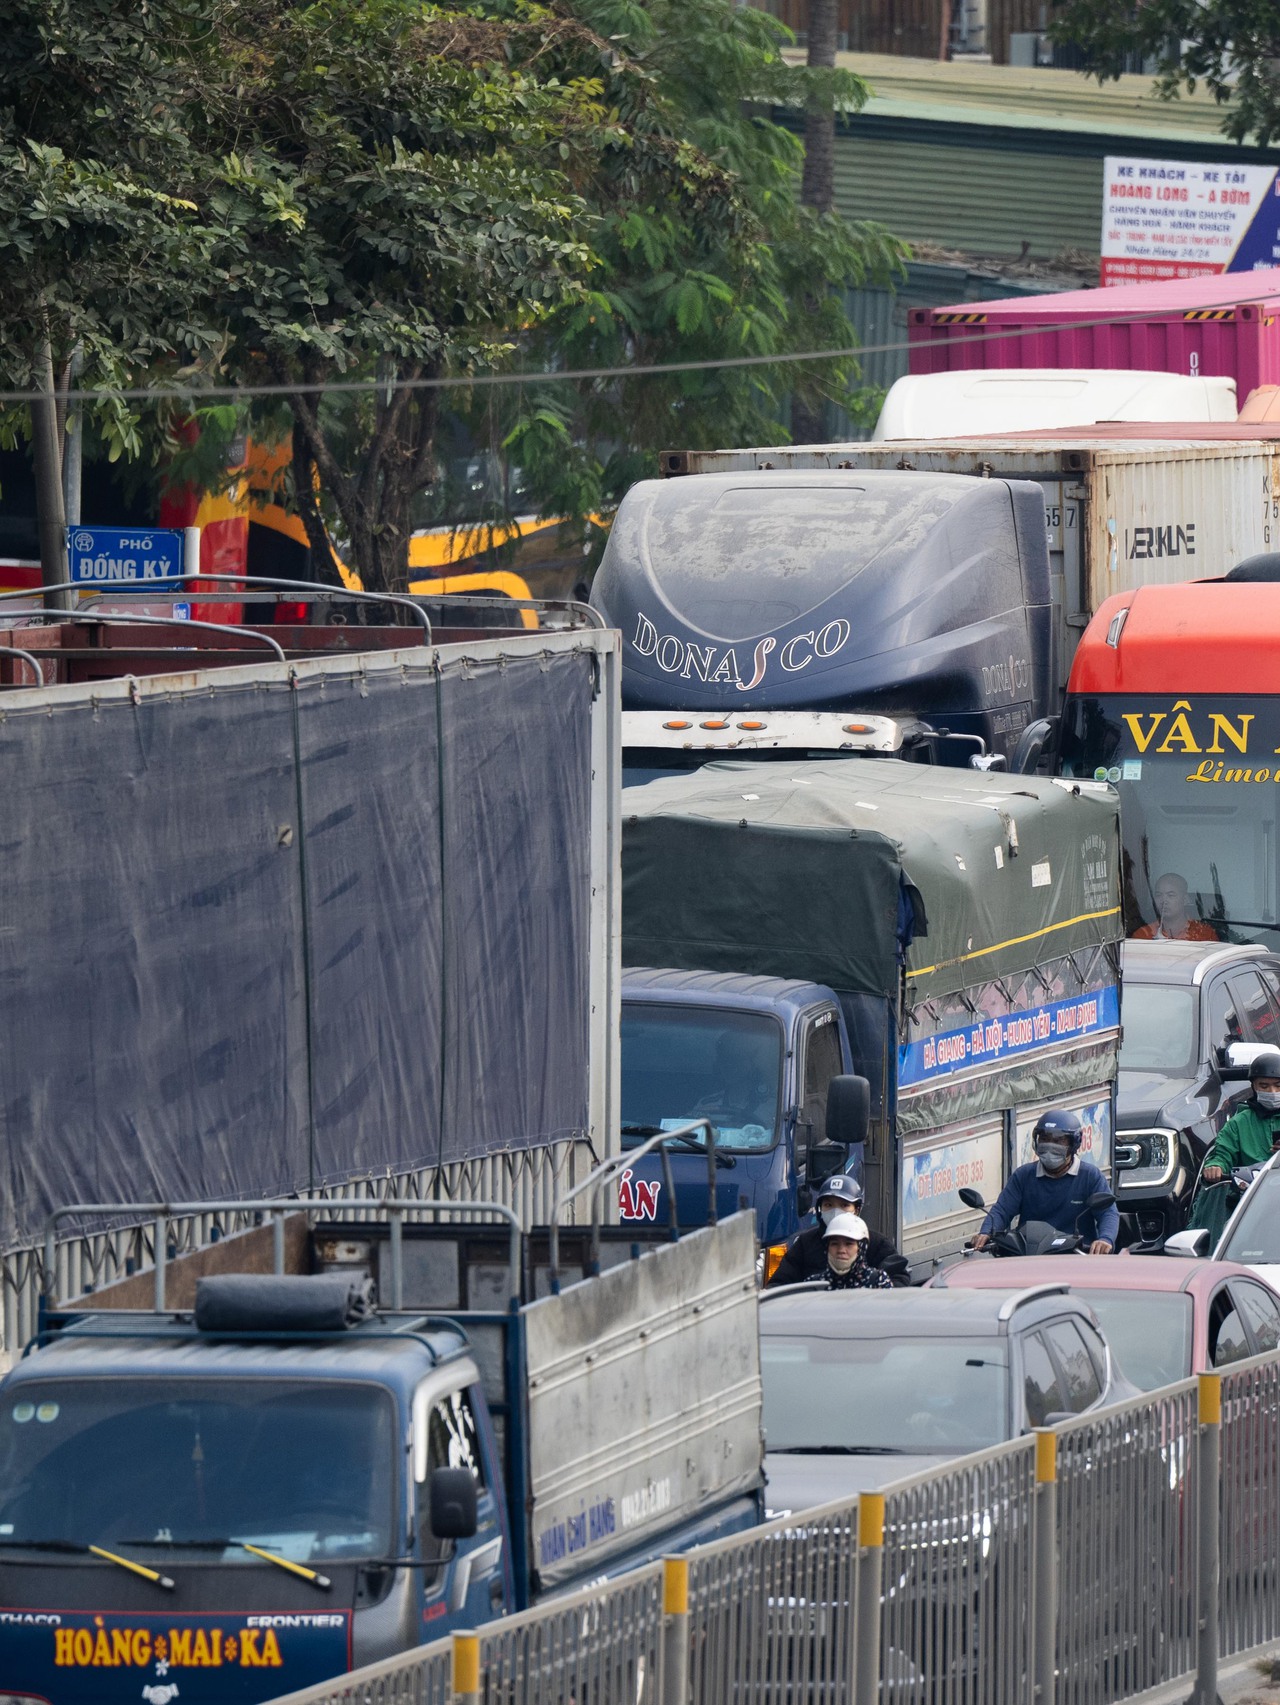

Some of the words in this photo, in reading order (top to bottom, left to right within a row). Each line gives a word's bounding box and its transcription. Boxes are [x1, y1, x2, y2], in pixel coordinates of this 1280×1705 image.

[1117, 166, 1134, 178] XE
[1139, 166, 1186, 180] KHÁCH
[1203, 171, 1220, 183] XE
[1110, 183, 1152, 201] HOÀNG
[1156, 188, 1190, 203] LONG
[120, 535, 154, 551] PHỐ
[79, 552, 137, 579] ĐỐNG
[143, 556, 171, 579] KỲ
[1122, 700, 1255, 753] VÂN
[924, 1037, 936, 1069] HÀ
[937, 1033, 965, 1063] GIANG
[972, 1024, 984, 1056] HÀ
[985, 1019, 1002, 1056] NỘI
[1008, 1018, 1032, 1048] HƯNG
[1033, 1009, 1050, 1041] YÊN
[1056, 1008, 1077, 1035] NAM
[1077, 1000, 1097, 1033] ĐỊNH
[247, 1614, 345, 1628] FRONTIER
[54, 1616, 152, 1667] HOÀNG
[168, 1628, 223, 1667] MAI
[240, 1628, 283, 1667] KA
